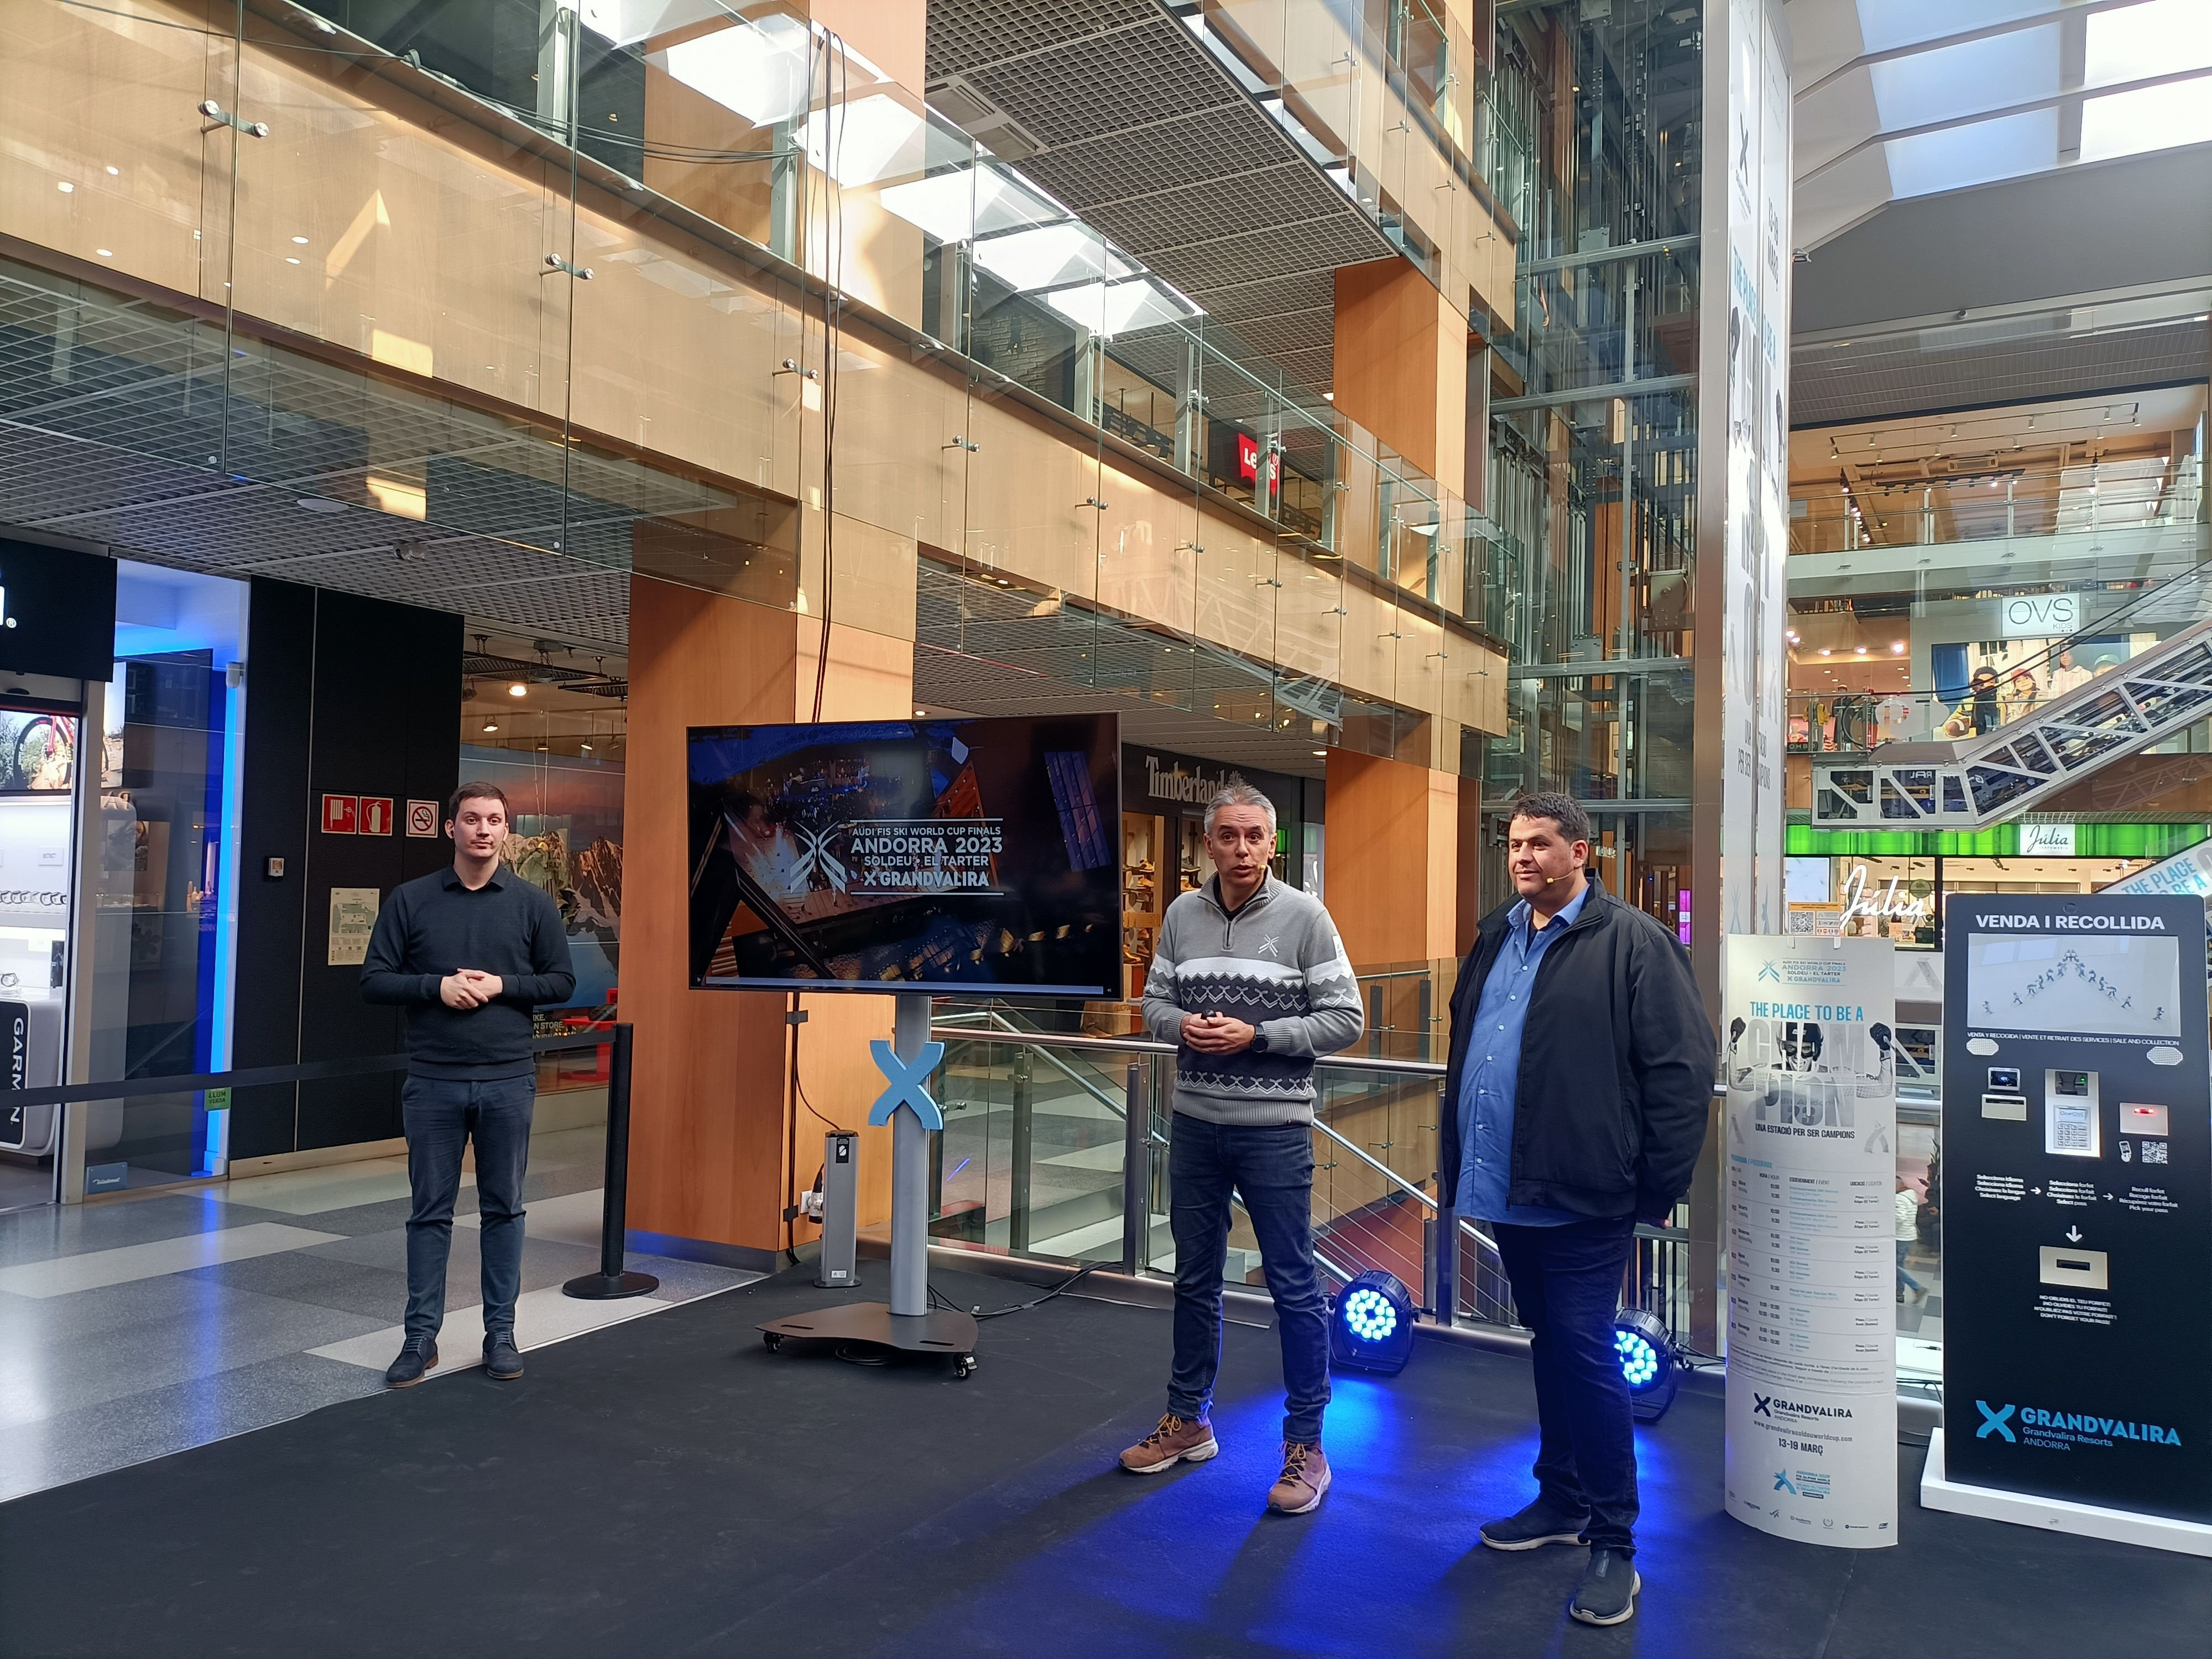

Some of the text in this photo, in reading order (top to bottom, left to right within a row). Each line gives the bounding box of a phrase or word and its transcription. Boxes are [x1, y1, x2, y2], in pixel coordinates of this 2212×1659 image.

[2008, 598, 2074, 625] OVS
[910, 827, 945, 836] WORLD
[946, 827, 966, 836] CUP
[968, 826, 1001, 835] FINALS
[2026, 825, 2069, 853] Júlia
[851, 837, 1003, 854] ANDORRA 2023
[864, 855, 989, 867] SOLDEU EL TARTER
[880, 870, 989, 887] GRANDVALIRA
[2121, 857, 2197, 894] THE PLACE
[2193, 874, 2208, 890] A
[1839, 864, 1927, 931] Júlia
[1976, 915, 2166, 930] VENDA I RECOLLIDA
[1750, 1001, 1864, 1021] THE PLACE TO BE A
[10, 1017, 24, 1123] GARMN
[1755, 1123, 1855, 1139] UNA ESTACIÓ PER SER CAMPIONS
[1773, 1399, 1853, 1418] GRANDVALIRA
[1774, 1409, 1800, 1418] Grandvalira
[1774, 1415, 1798, 1423] ANDORRA
[2021, 1407, 2182, 1447] GRANDVALIRA
[2022, 1426, 2114, 1447] Grandvalira Resorts
[2023, 1437, 2070, 1451] ANDORRA
[1778, 1437, 1823, 1456] 13-19 MARÇ
